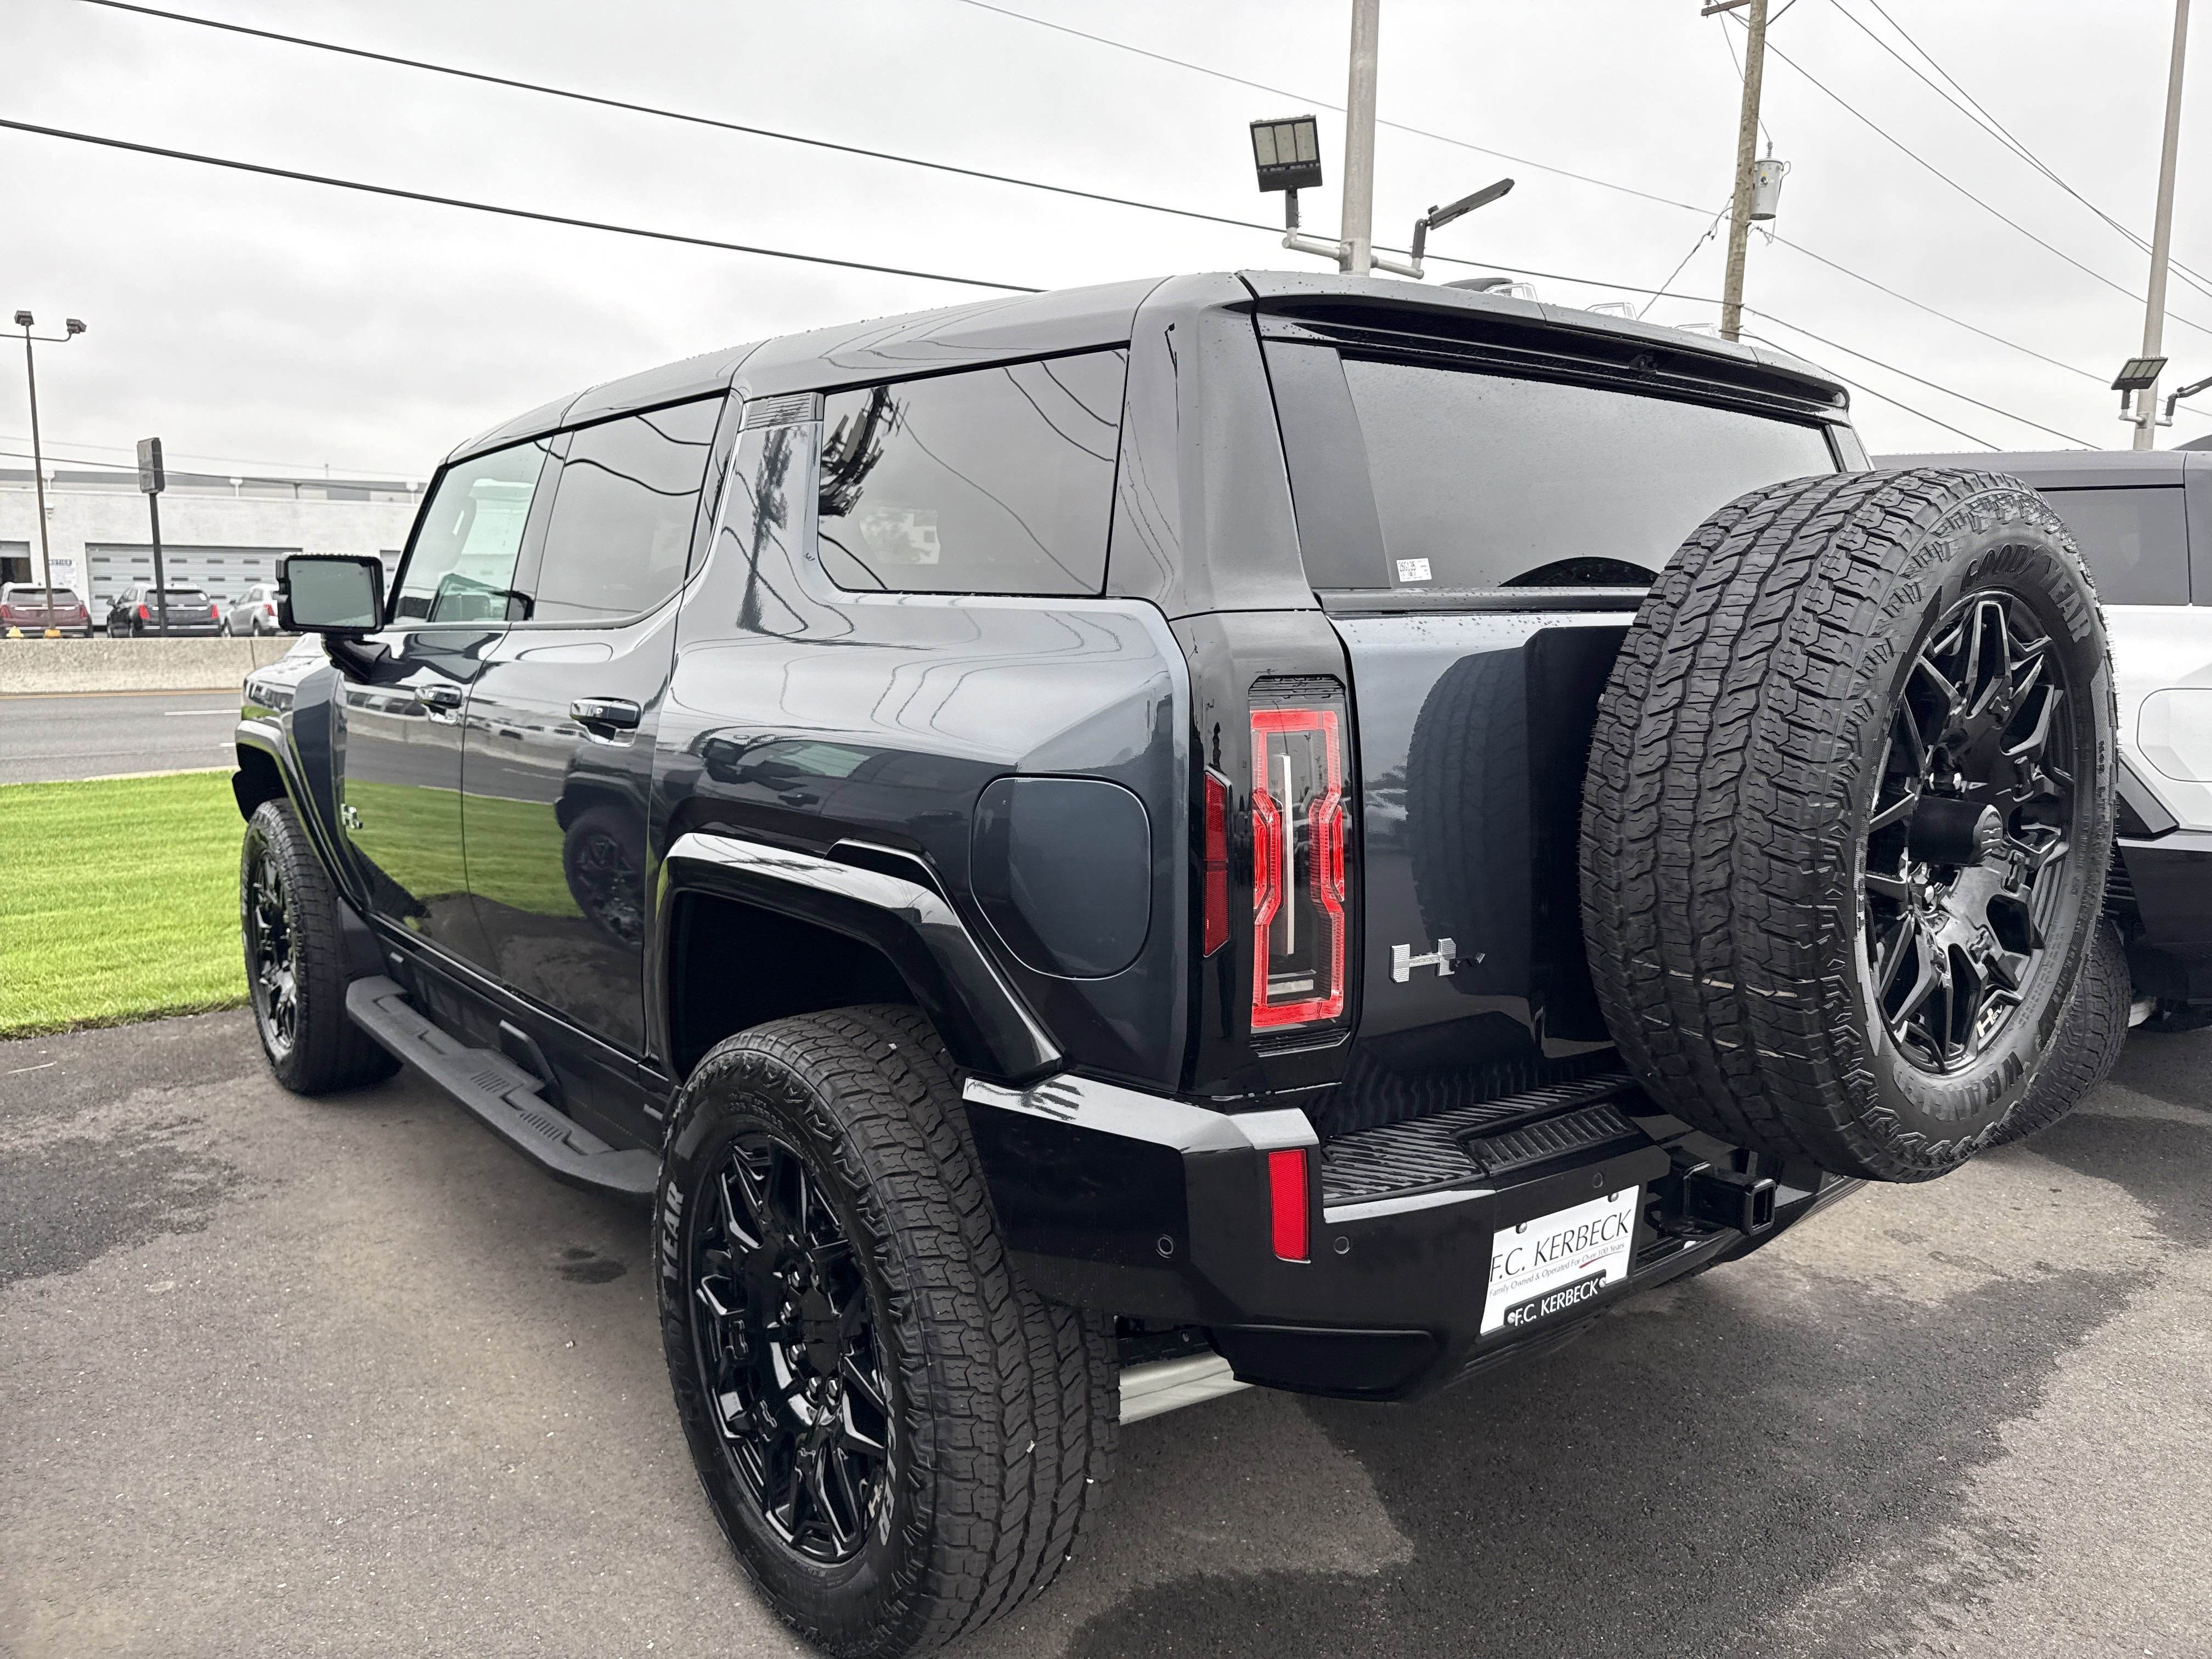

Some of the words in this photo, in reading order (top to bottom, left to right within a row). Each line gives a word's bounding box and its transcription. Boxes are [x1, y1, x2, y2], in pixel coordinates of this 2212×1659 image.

[1489, 1283, 1509, 1297] Family
[1511, 1274, 1534, 1289] Owned
[1535, 1272, 1541, 1280] &
[1542, 1260, 1570, 1279] Operated
[1571, 1258, 1581, 1267] For
[1582, 1252, 1596, 1262] Over
[1598, 1247, 1609, 1256] 100
[1610, 1243, 1624, 1252] Years
[1490, 1247, 1525, 1282] F.C.
[1534, 1209, 1632, 1266] KERBECK
[1515, 1304, 1536, 1327] F.C.
[1541, 1278, 1599, 1316] KERBECK
